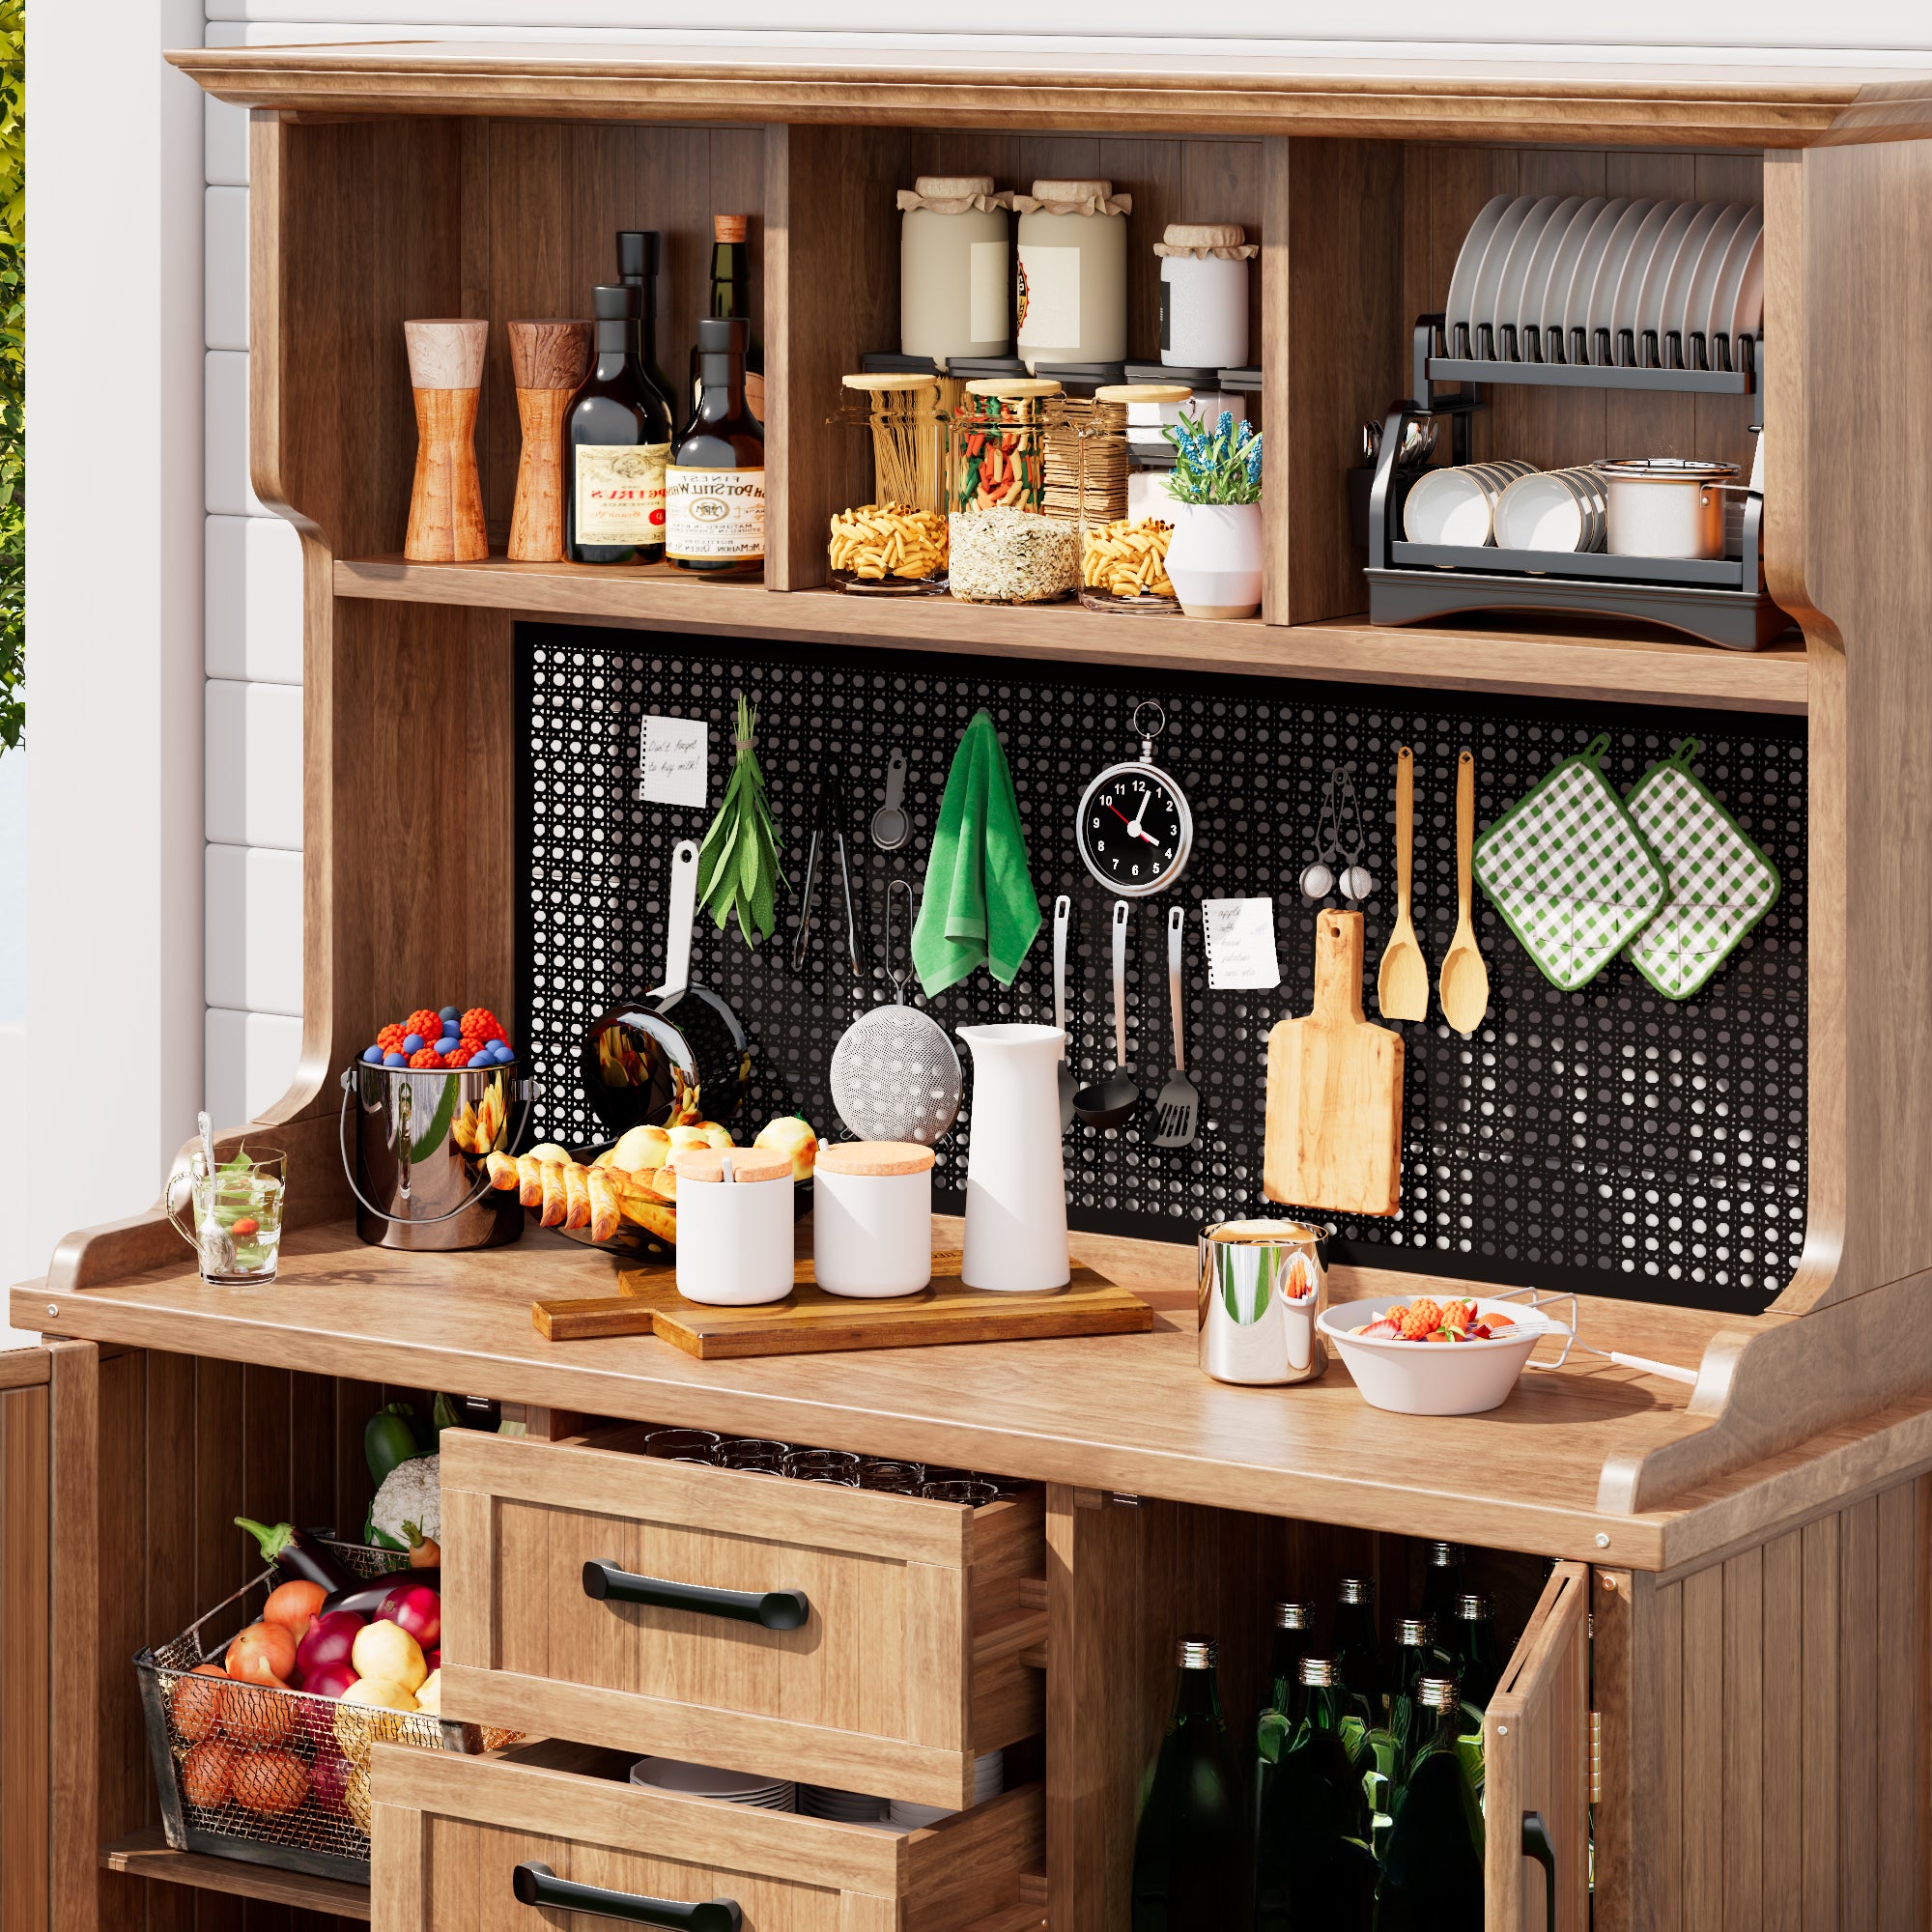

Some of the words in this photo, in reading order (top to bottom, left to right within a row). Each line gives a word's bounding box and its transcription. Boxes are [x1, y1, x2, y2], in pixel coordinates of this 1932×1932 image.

[649, 761, 657, 772] to
[1114, 783, 1125, 795] 11
[1132, 780, 1146, 792] 12
[1155, 787, 1162, 799] 1
[1099, 794, 1113, 807] 10
[1165, 801, 1174, 811] 2
[1093, 817, 1100, 829] 9
[1170, 825, 1178, 836] 3
[1097, 840, 1105, 852] 8
[1164, 848, 1172, 860] 4
[1112, 859, 1120, 870] 7
[1131, 865, 1139, 876] 6
[1152, 863, 1160, 874] 5
